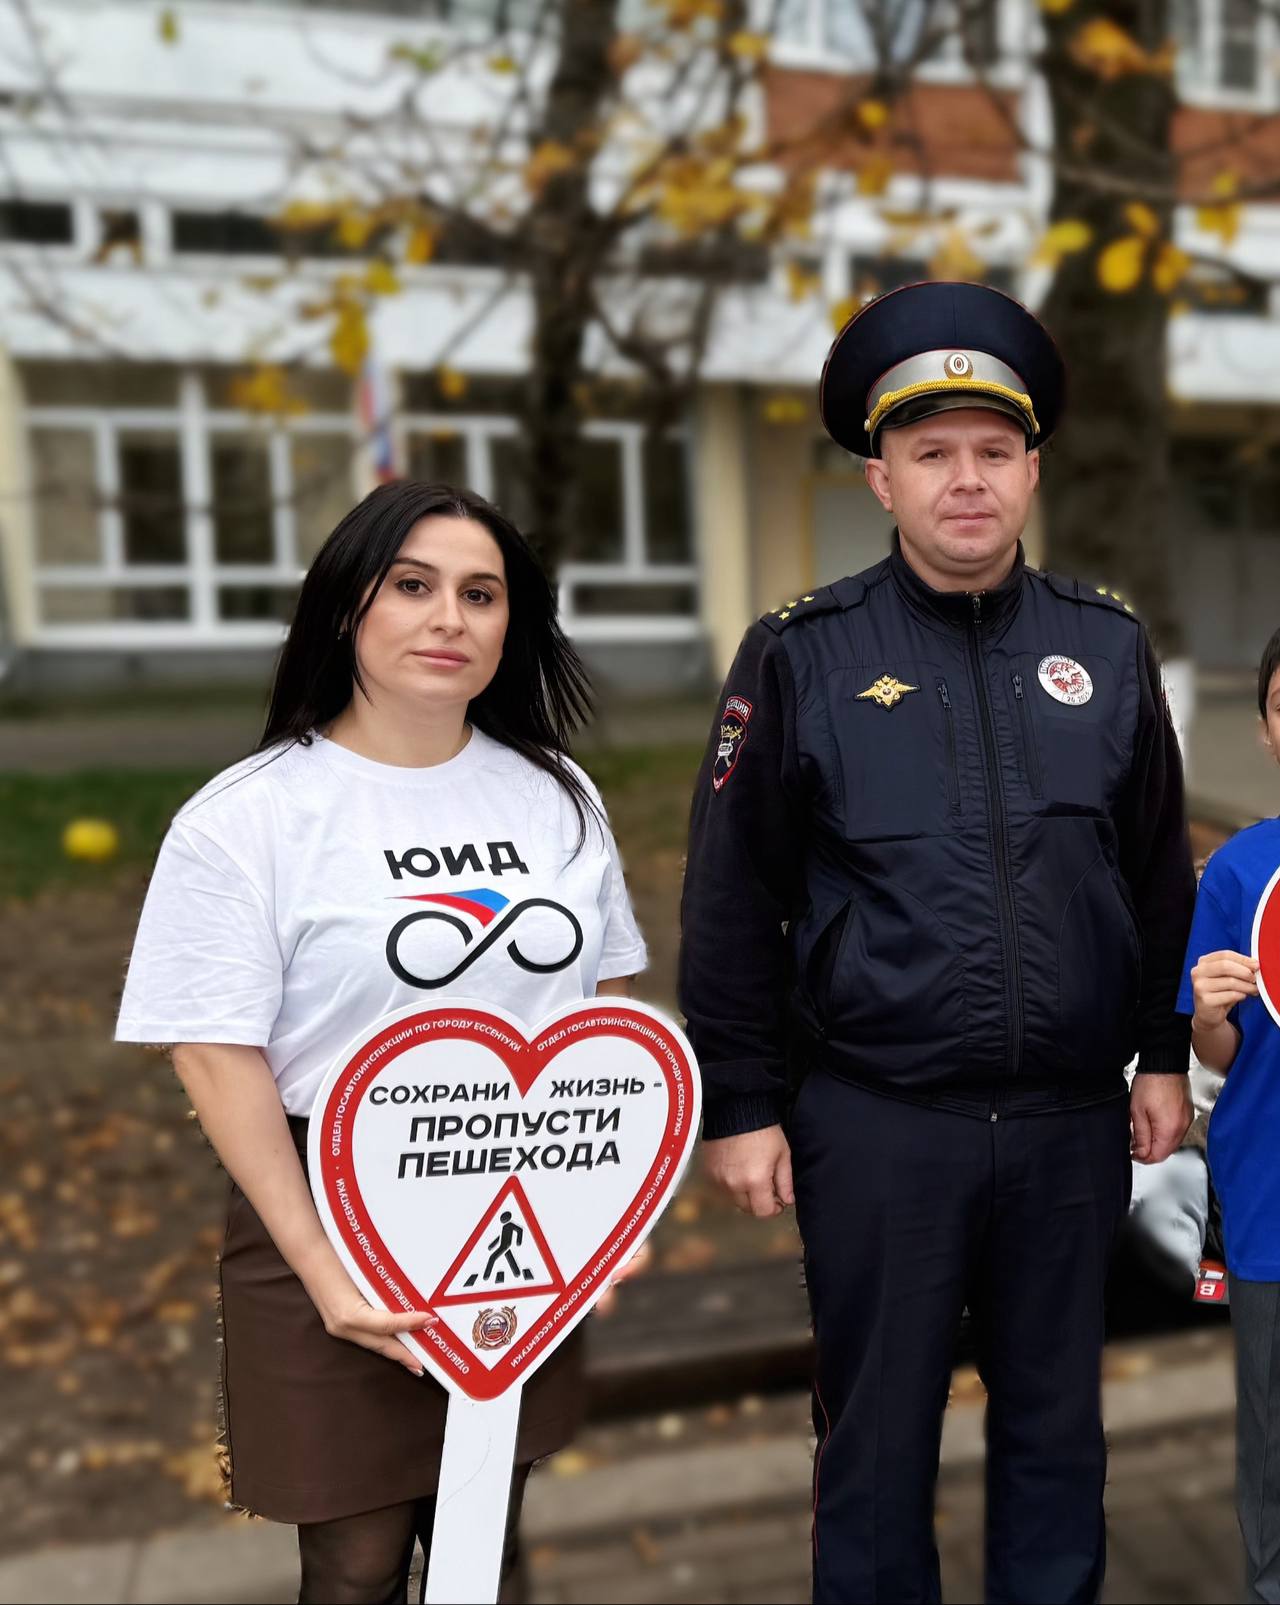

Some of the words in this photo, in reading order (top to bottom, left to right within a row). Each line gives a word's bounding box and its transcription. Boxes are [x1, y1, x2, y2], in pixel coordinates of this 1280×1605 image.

[383, 841, 530, 880] ЮИД
[415, 1023, 430, 1034] ПО
[433, 1019, 474, 1029] ГОРОДУ
[473, 1022, 522, 1052] ЕССЕНТУКИ
[336, 1027, 414, 1119] ГОСАВТОИНСПЕКЦИИ
[537, 1030, 566, 1052] ОТДЕЛ
[567, 1017, 657, 1043] ГОСАВТОИНСПЕКЦИИ
[656, 1037, 667, 1050] ПО
[665, 1049, 683, 1084] ГОРОДУ
[674, 1083, 685, 1136] ЕССЕНТУКИ
[369, 1082, 510, 1106] СОХРАНИ
[549, 1077, 645, 1099] ЖИЗНЬ
[332, 1120, 342, 1157] ОТДЕЛ
[409, 1107, 621, 1143] ПРОПУСТИ
[398, 1141, 621, 1179] ПЕШЕХОДА
[652, 1156, 671, 1187] ОТДЕЛ
[336, 1178, 360, 1233] ЕССЕНТУКИ
[356, 1232, 379, 1266] ГОРОДУ
[592, 1186, 657, 1277] ГОСАВТОИНСПЕКЦИИ
[375, 1266, 388, 1280] ПО
[580, 1276, 594, 1290] ПО
[553, 1287, 582, 1324] ГОРОДУ
[510, 1321, 553, 1368] ЕССЕНТУКИ
[447, 1350, 470, 1376] ОТДЕЛ
